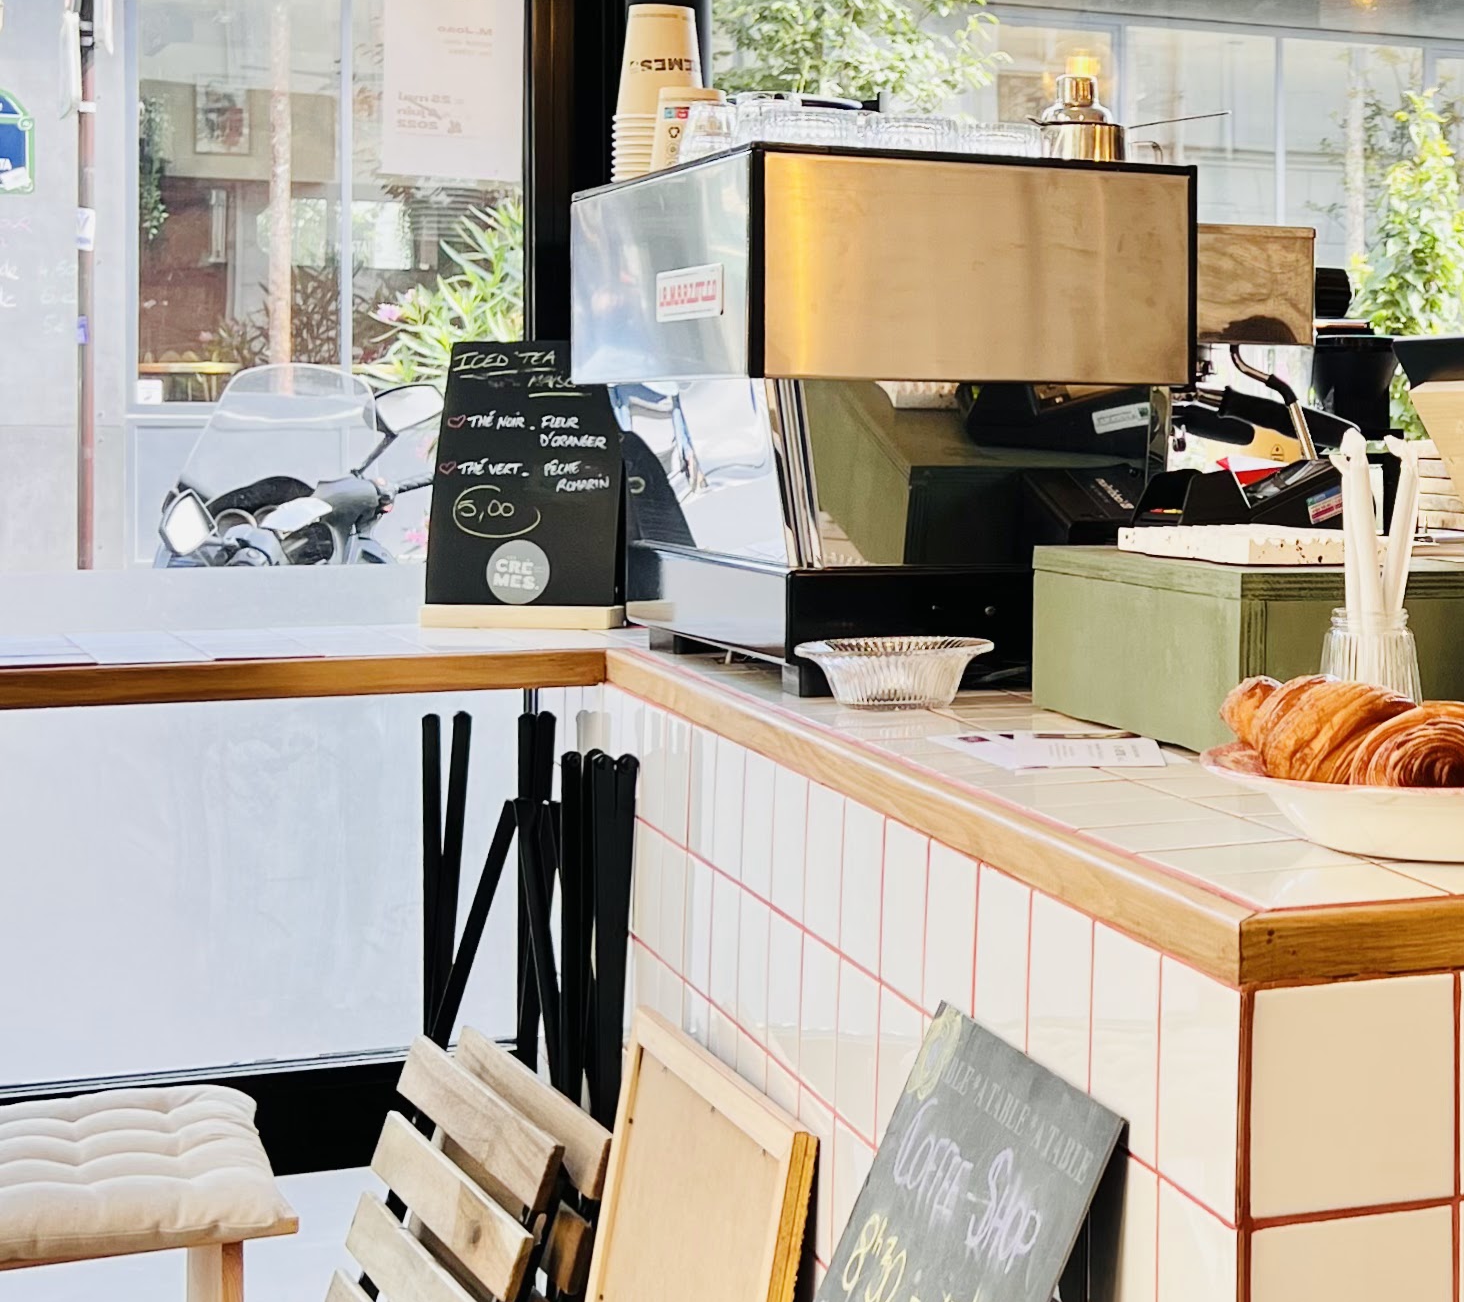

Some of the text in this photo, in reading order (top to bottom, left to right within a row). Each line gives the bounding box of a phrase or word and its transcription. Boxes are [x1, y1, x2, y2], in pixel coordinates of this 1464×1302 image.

[453, 350, 556, 371] ICED TEA
[467, 410, 496, 429] THÉ
[541, 414, 579, 429] FLEUR
[540, 431, 607, 449] D'ORANGER
[457, 458, 582, 476] THÉ VERT PÊCHE
[457, 499, 514, 523] 5,00
